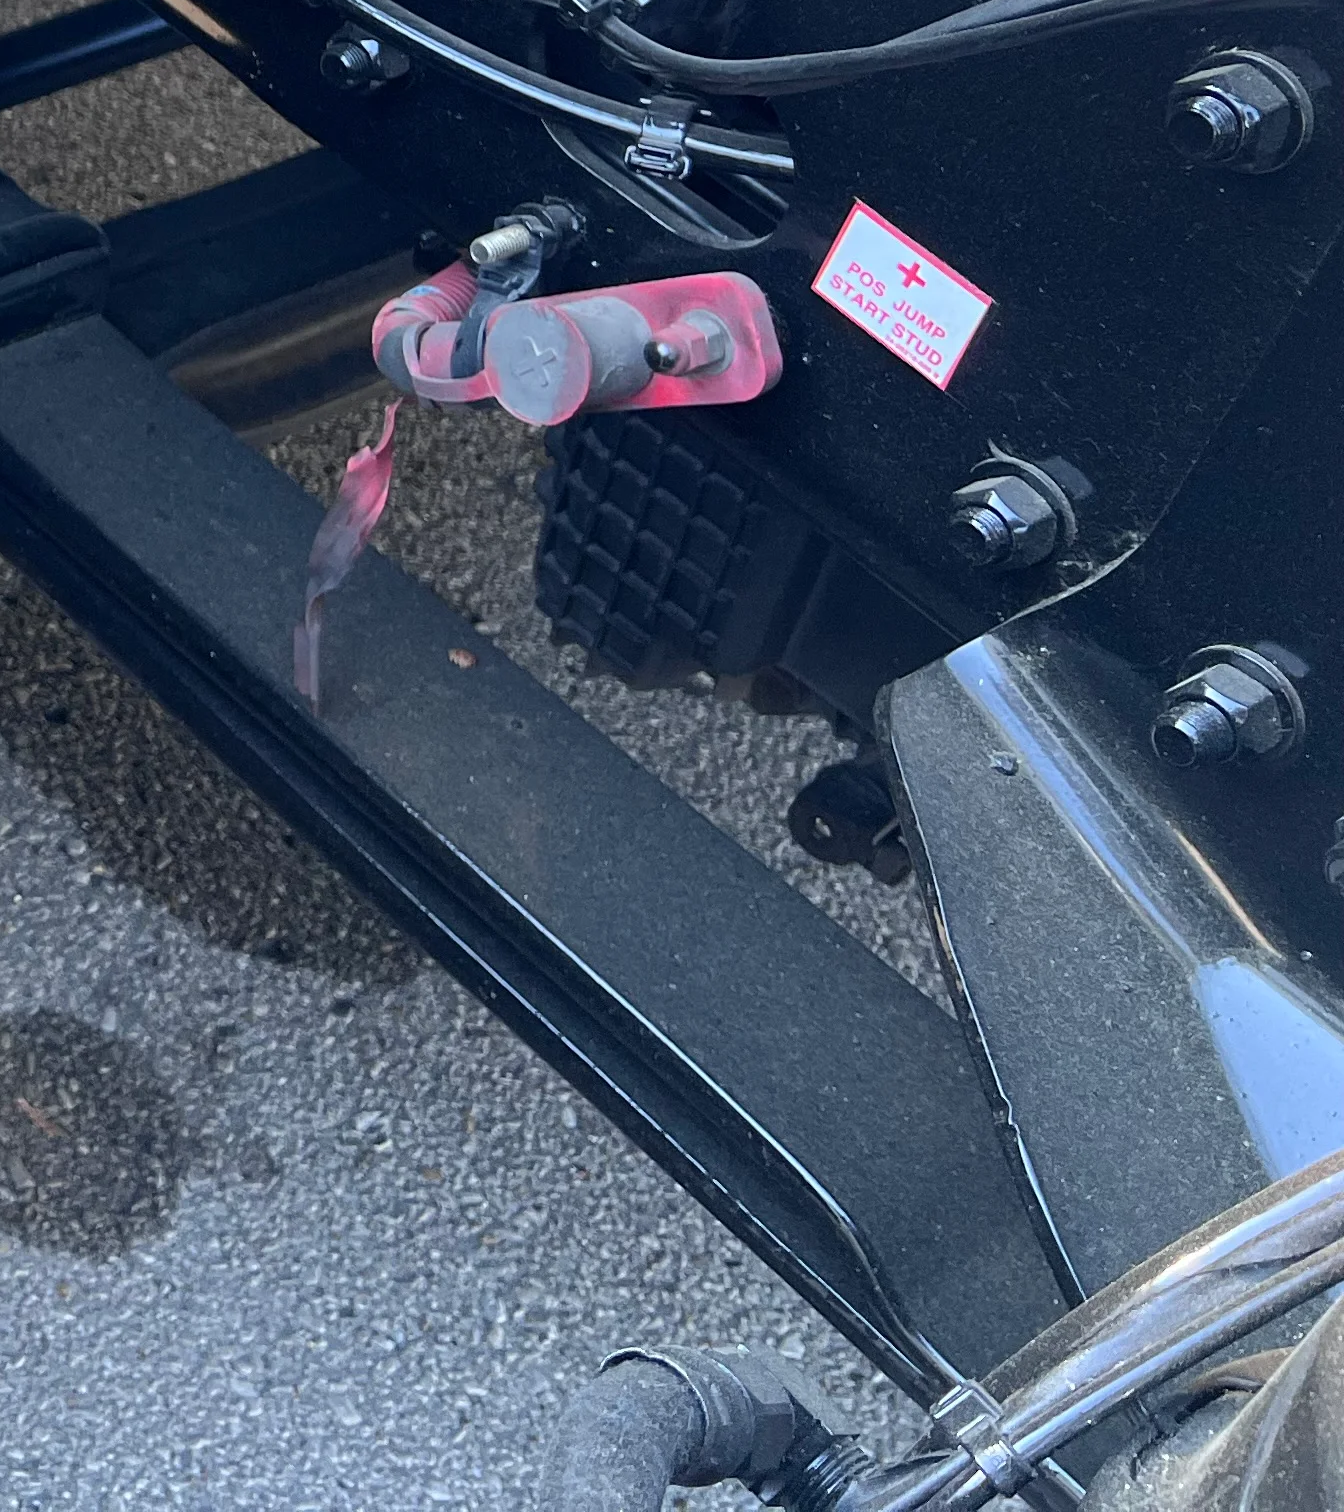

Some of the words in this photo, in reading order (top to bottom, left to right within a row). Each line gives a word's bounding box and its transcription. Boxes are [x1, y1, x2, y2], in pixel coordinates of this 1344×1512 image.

[830, 274, 890, 324] START
[892, 322, 942, 366] STUD
[847, 261, 886, 297] POS
[893, 300, 946, 339] JUMP
